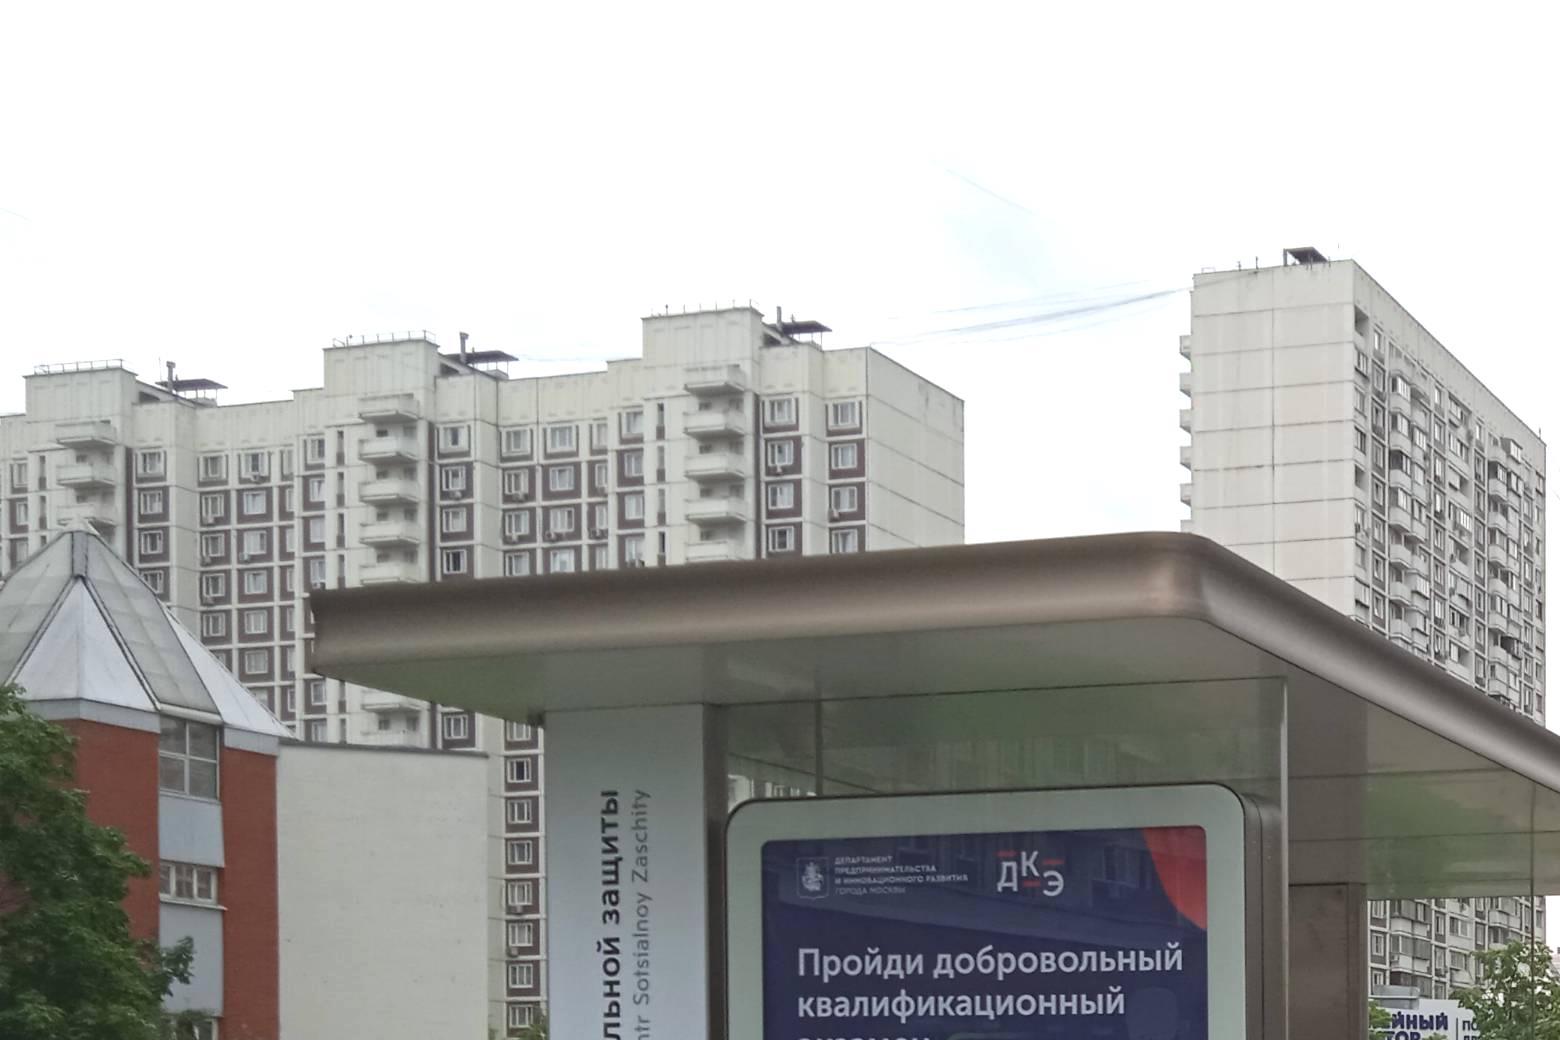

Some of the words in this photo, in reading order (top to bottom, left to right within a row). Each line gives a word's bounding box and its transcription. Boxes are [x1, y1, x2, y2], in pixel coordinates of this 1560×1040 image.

[600, 790, 624, 925] защиты
[630, 789, 651, 883] Zaschity
[632, 892, 653, 1006] Sotsialnoy
[797, 946, 925, 983] Пройди
[932, 942, 1184, 981] добровольный
[797, 985, 1126, 1024] квалификационный
[1387, 1011, 1449, 1031] ЙНЫЙ
